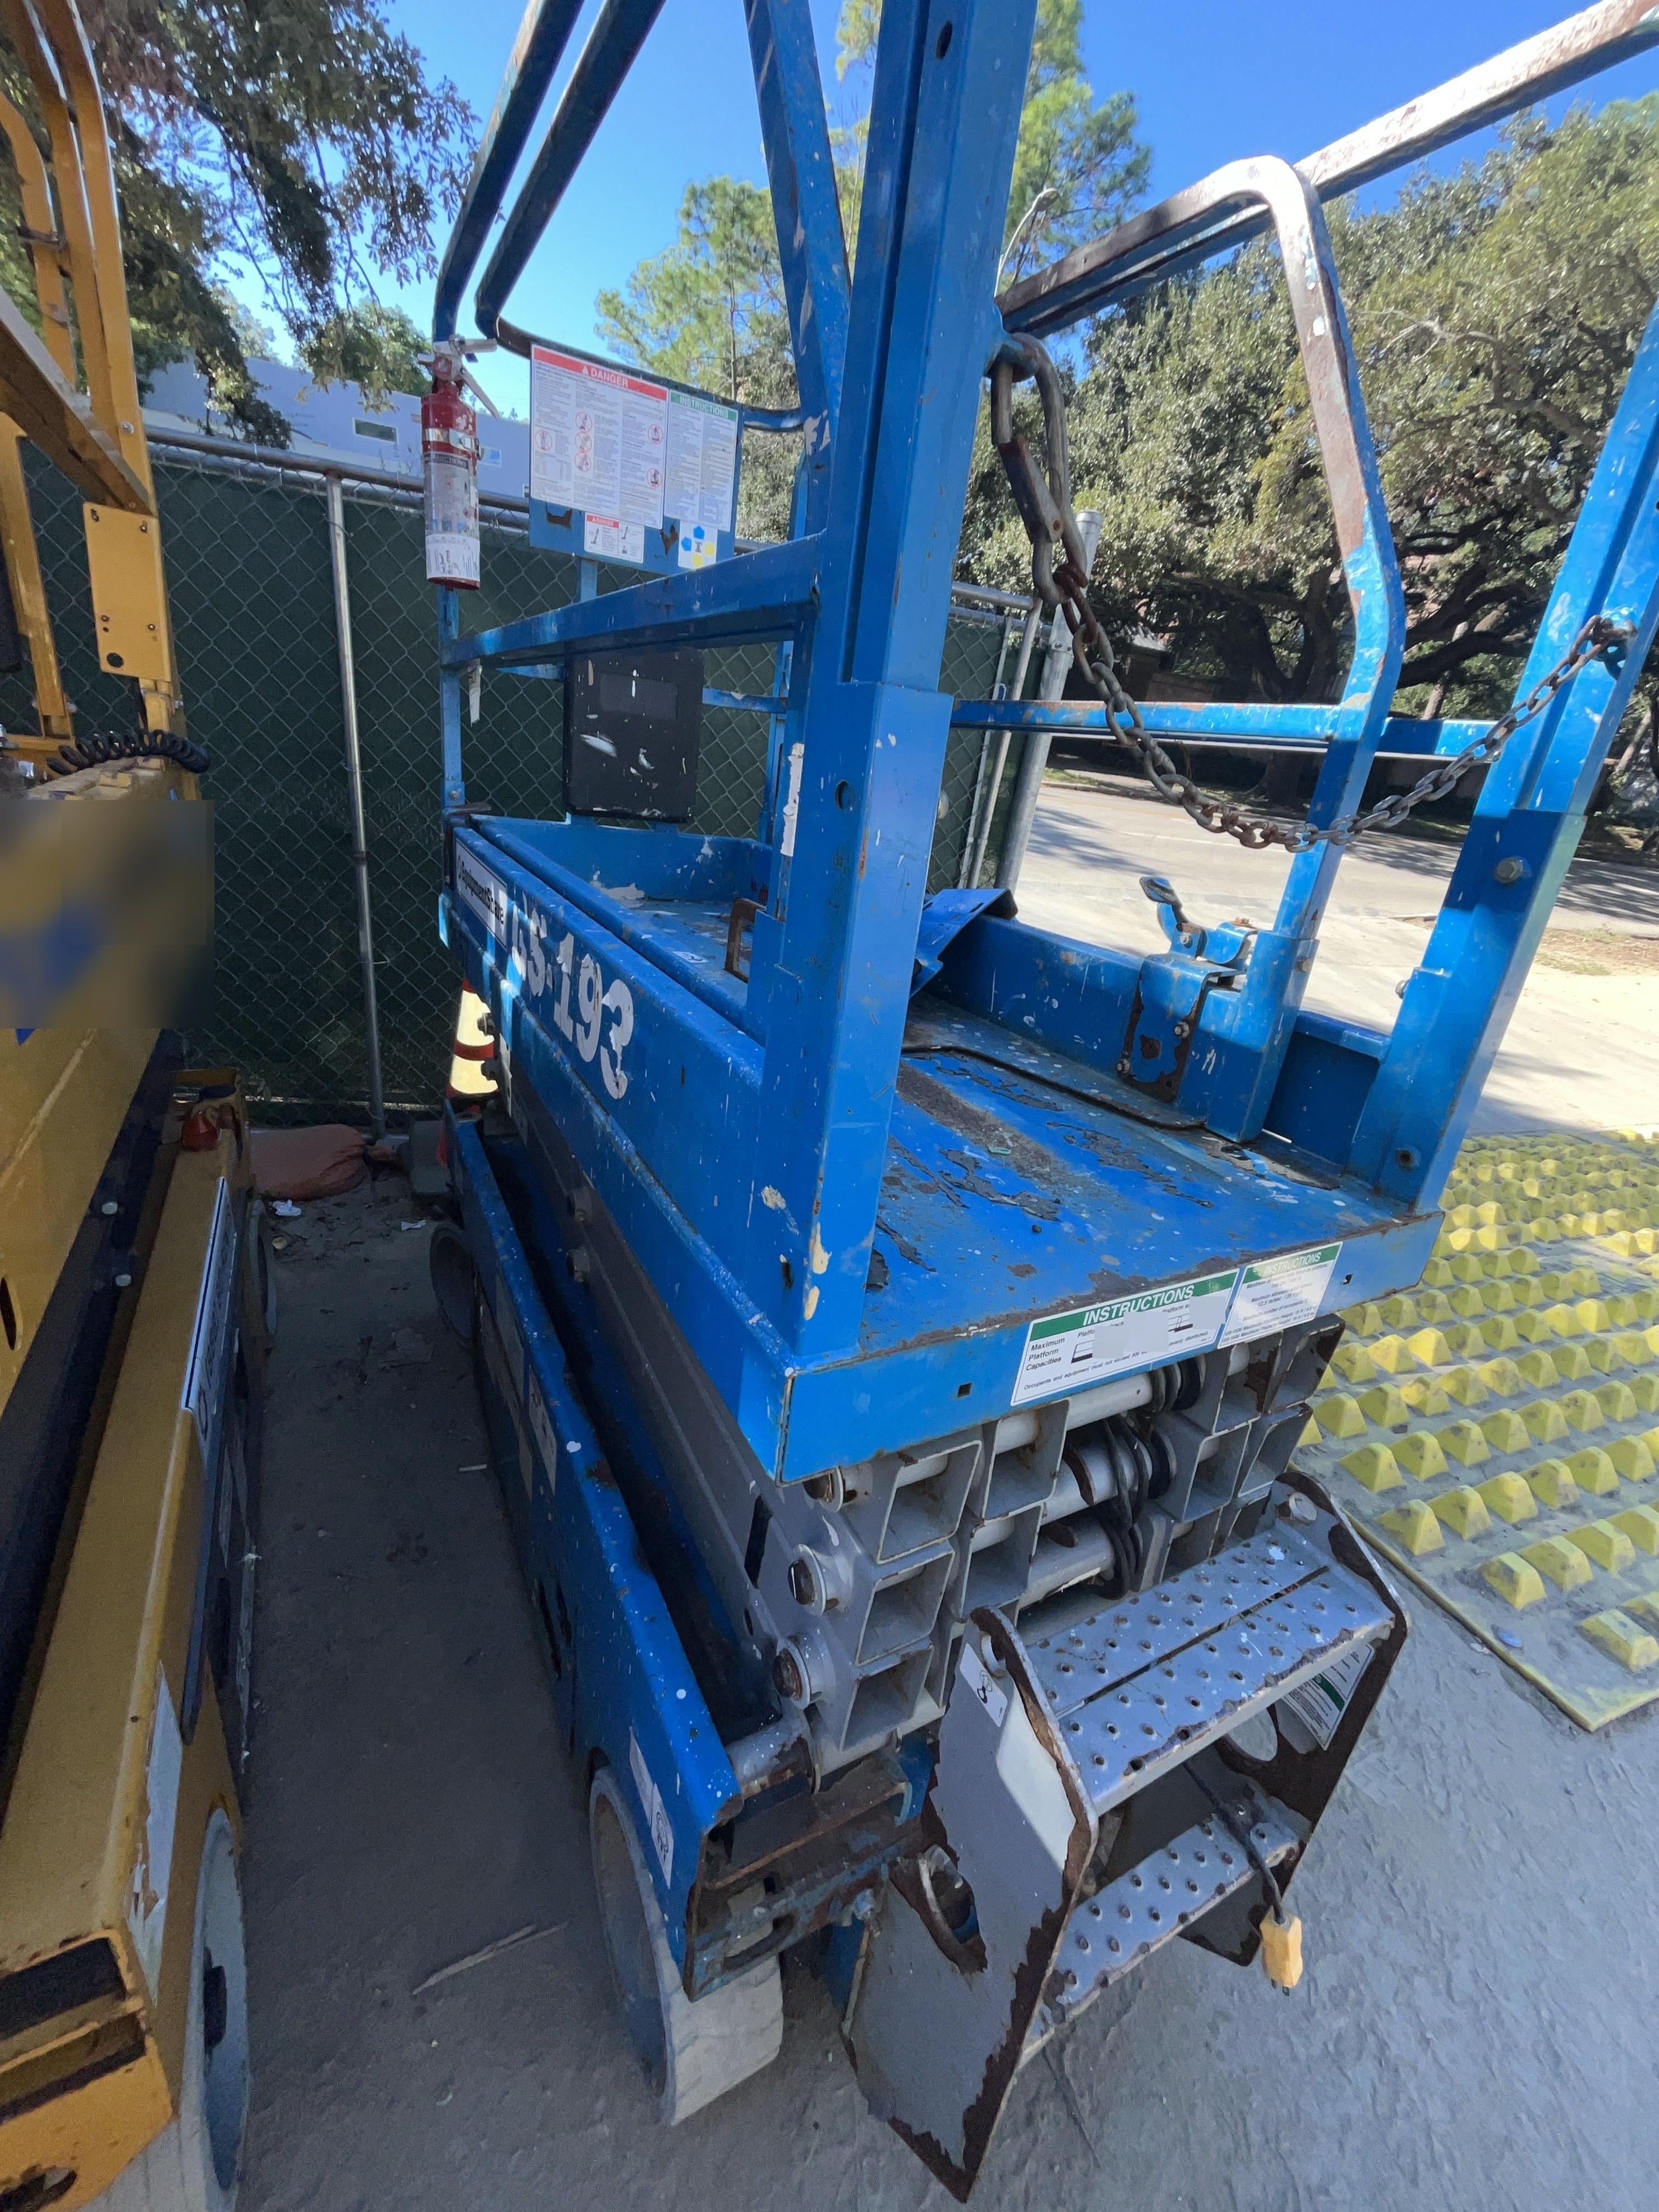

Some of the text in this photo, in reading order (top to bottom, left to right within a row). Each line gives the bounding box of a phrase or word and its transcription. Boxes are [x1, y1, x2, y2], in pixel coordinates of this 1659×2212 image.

[591, 368, 629, 388] DANGER
[680, 396, 729, 419] INSTRUCTIONS
[1263, 1252, 1321, 1276] INSTRUCTIONS
[1083, 1285, 1195, 1327] INSTRUCTIONS
[1031, 1336, 1065, 1351] Maximum
[1077, 1329, 1095, 1338] Platfo
[1026, 1356, 1062, 1371] Capacities
[1029, 1348, 1059, 1361] Platform
[1024, 1378, 1051, 1390] Occupants
[1064, 1367, 1089, 1378] equipment
